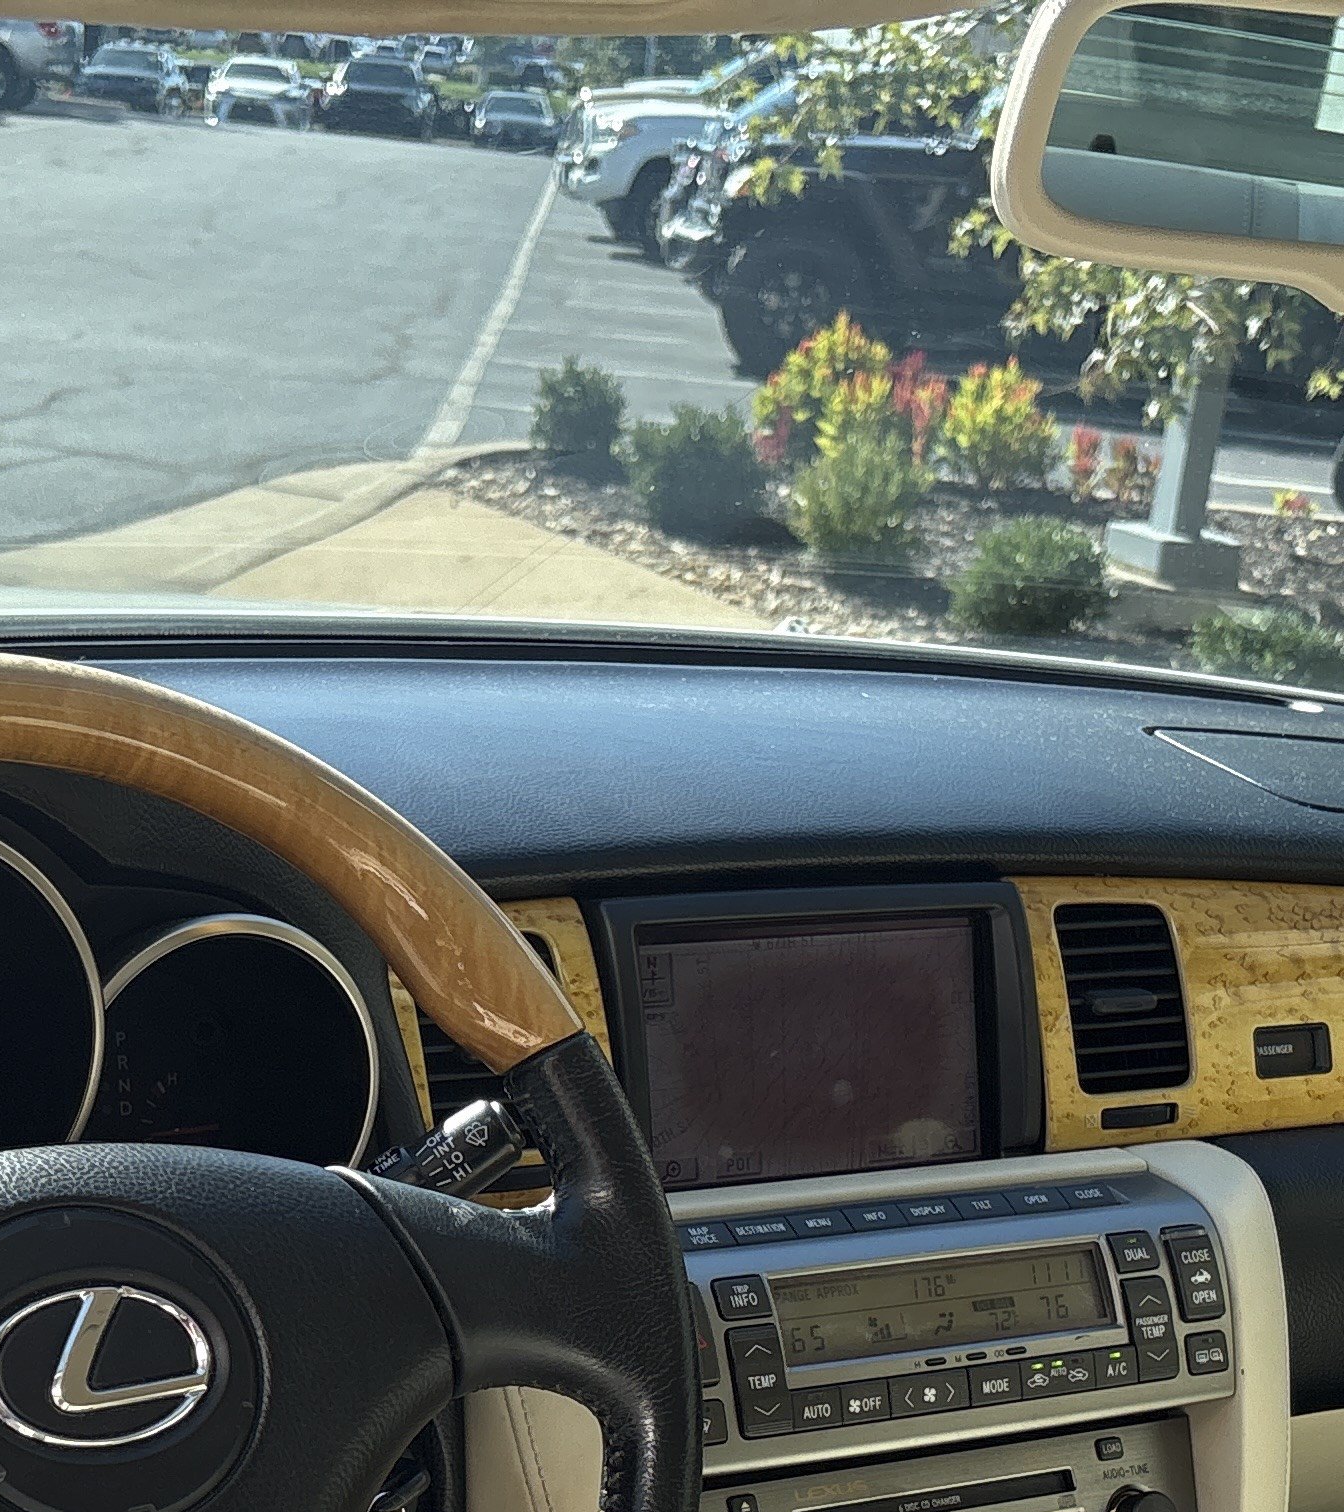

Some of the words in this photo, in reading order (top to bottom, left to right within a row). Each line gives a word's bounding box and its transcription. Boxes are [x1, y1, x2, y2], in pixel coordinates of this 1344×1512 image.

[115, 1031, 126, 1047] P
[117, 1055, 129, 1070] R
[118, 1078, 131, 1093] N
[119, 1100, 133, 1116] D
[432, 1136, 456, 1159] INT
[373, 1153, 401, 1174] TIME
[442, 1151, 464, 1170] LO
[452, 1162, 474, 1182] HI
[1023, 1194, 1049, 1205] OPEN
[1074, 1188, 1104, 1199] CLOSE
[909, 1204, 946, 1217] DISPLAY
[971, 1199, 992, 1210] TILT
[805, 1217, 832, 1229] MENU
[863, 1210, 887, 1222] INFO
[687, 1226, 710, 1237] MAP
[735, 1222, 787, 1236] DESTINATION
[690, 1233, 719, 1245] VOICE
[1124, 1248, 1151, 1262] DUAL
[1181, 1248, 1211, 1264] CLOSE
[816, 1283, 860, 1299] APPROX
[913, 1275, 946, 1299] 176
[730, 1292, 758, 1309] INFO
[1192, 1290, 1217, 1305] OPEN
[1039, 1293, 1069, 1320] 76
[1136, 1314, 1168, 1326] PASSENGER
[790, 1324, 825, 1353] 65
[1141, 1324, 1166, 1340] TEMP
[1106, 1362, 1127, 1377] A/C
[747, 1375, 777, 1390] TEMP
[982, 1378, 1010, 1394] MODE
[803, 1403, 831, 1419] AUTO
[861, 1396, 882, 1411] OFF
[1102, 1463, 1150, 1479] AUDIO-TUNE
[794, 1481, 869, 1501] LEXUS
